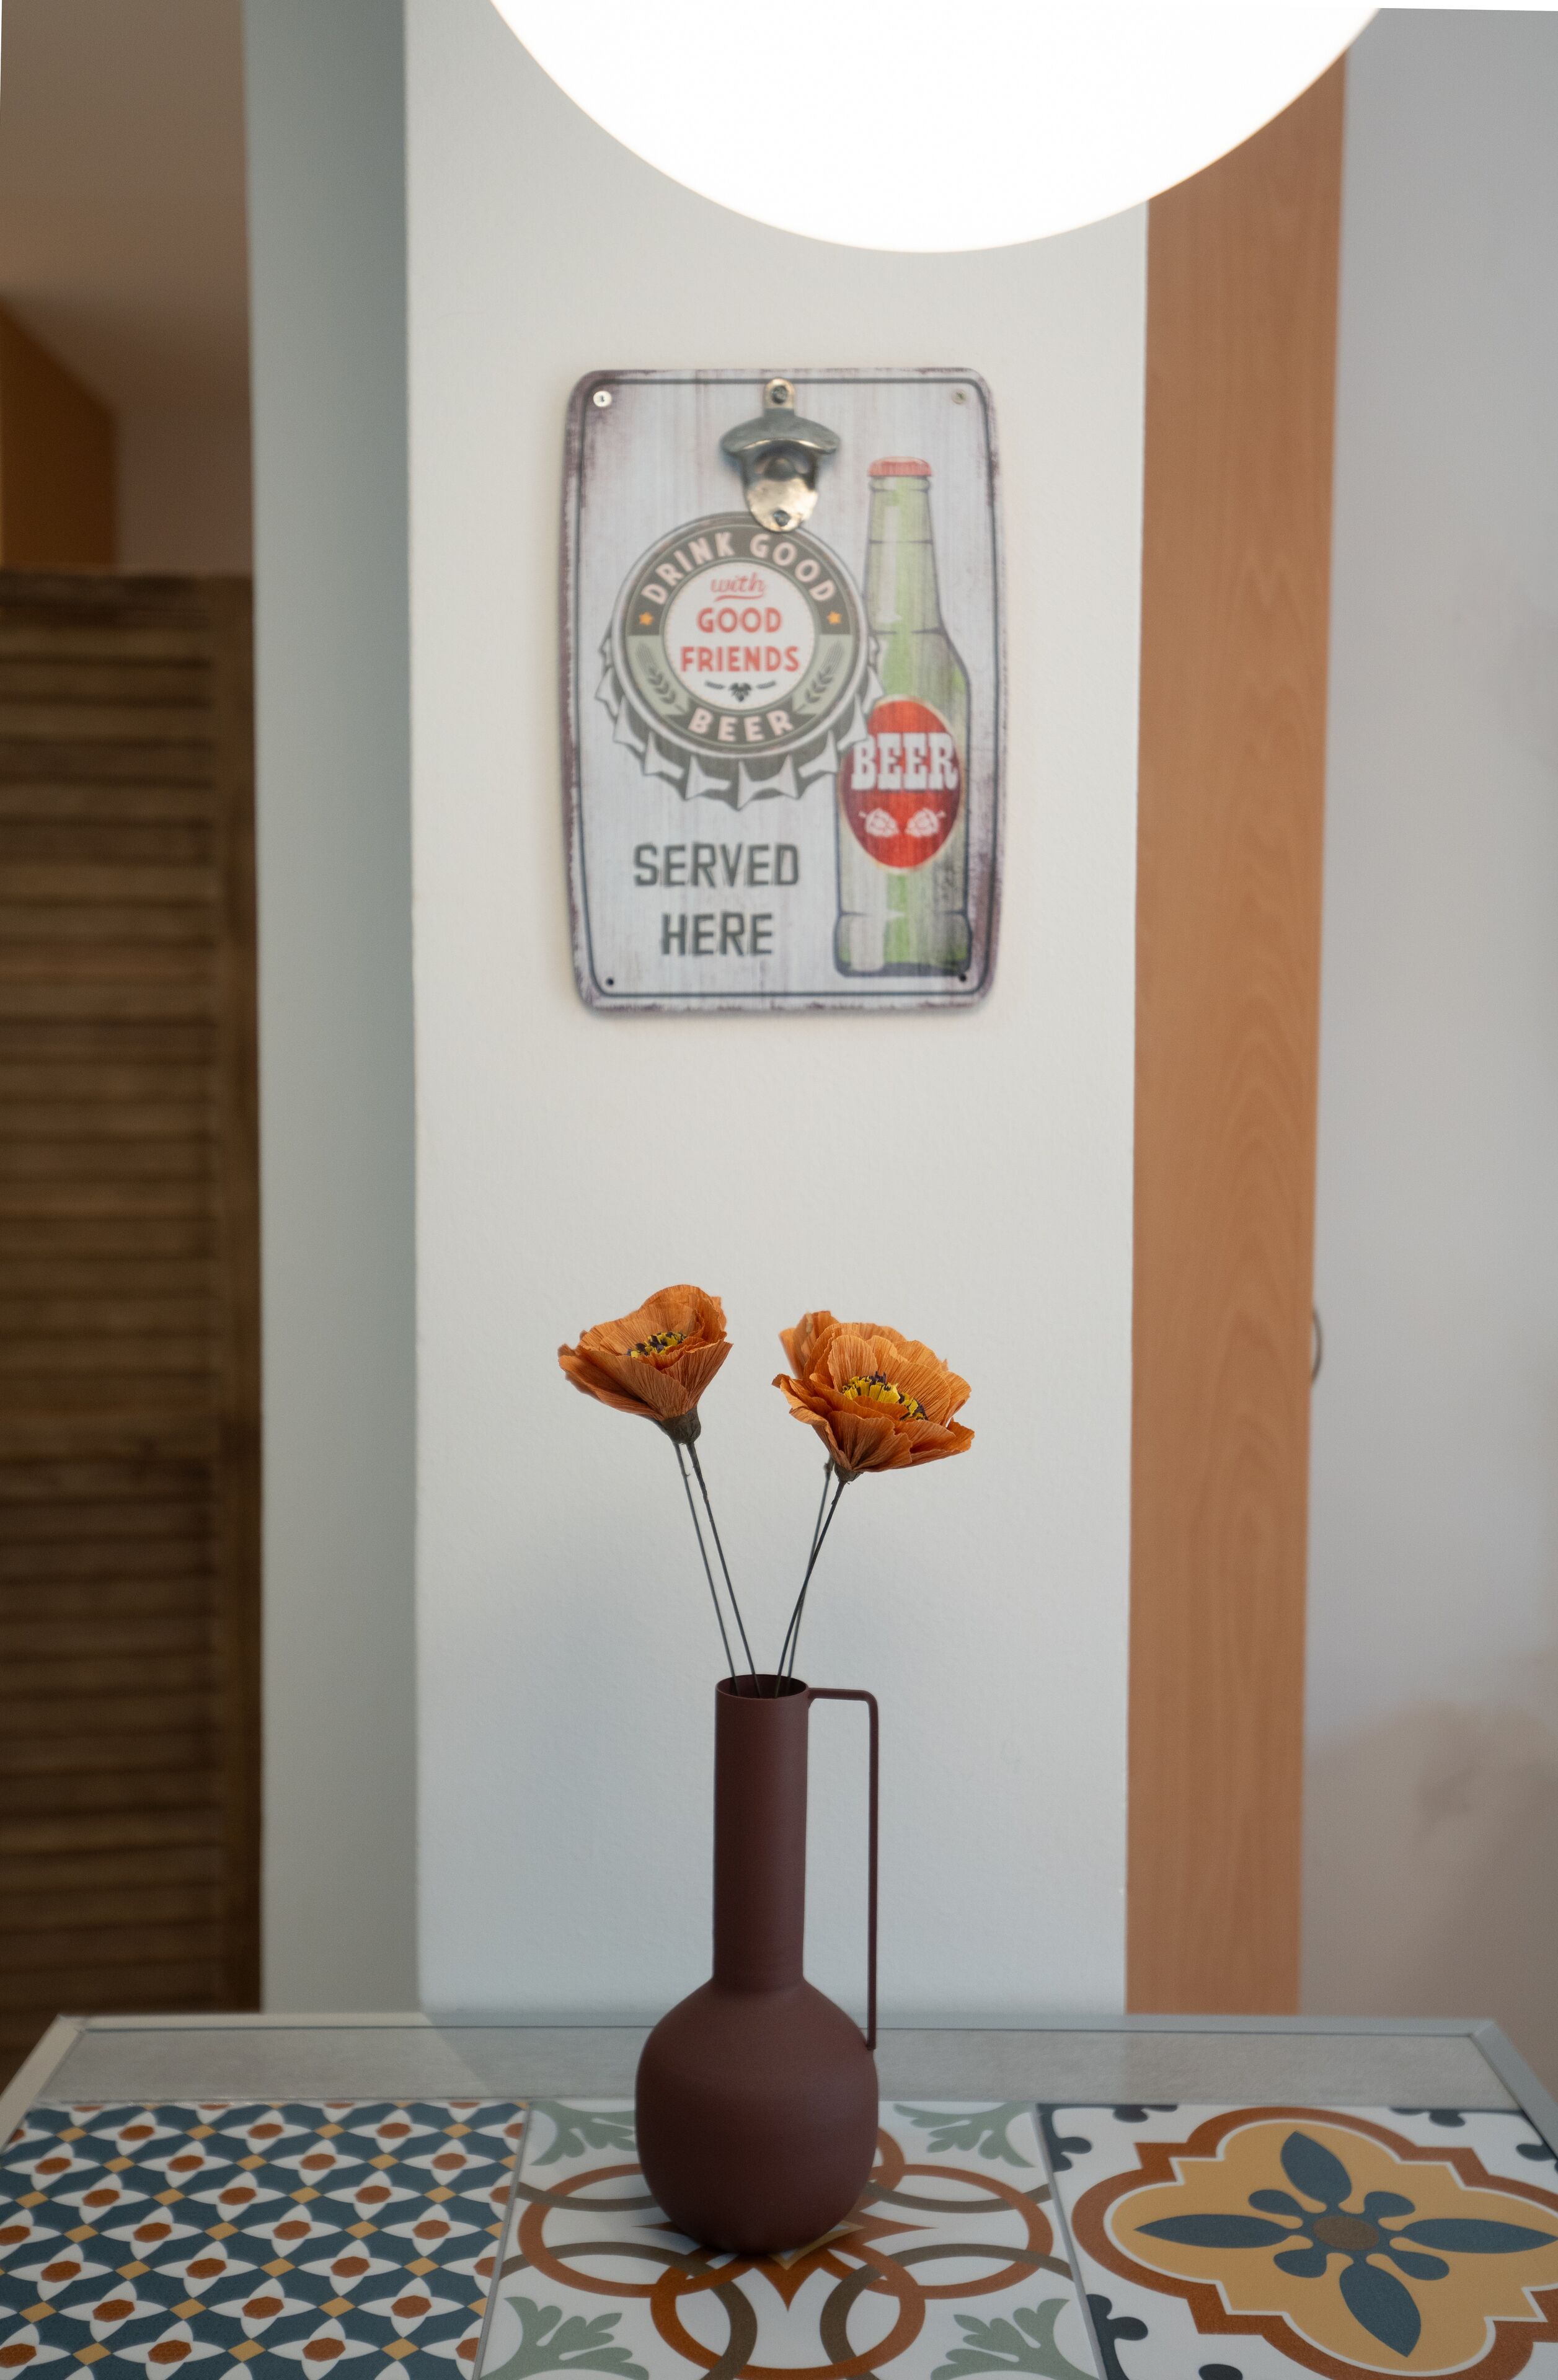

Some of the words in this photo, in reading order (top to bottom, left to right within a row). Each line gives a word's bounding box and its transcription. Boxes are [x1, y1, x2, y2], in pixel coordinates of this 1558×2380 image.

[641, 532, 735, 605] DRINK
[750, 533, 835, 601] GOOD
[710, 571, 767, 594] with
[696, 607, 782, 633] GOOD
[681, 646, 800, 672] FRIENDS
[688, 707, 794, 742] BEER
[851, 732, 959, 790] BEER
[633, 842, 799, 888] SERVED
[661, 912, 772, 956] HERE
